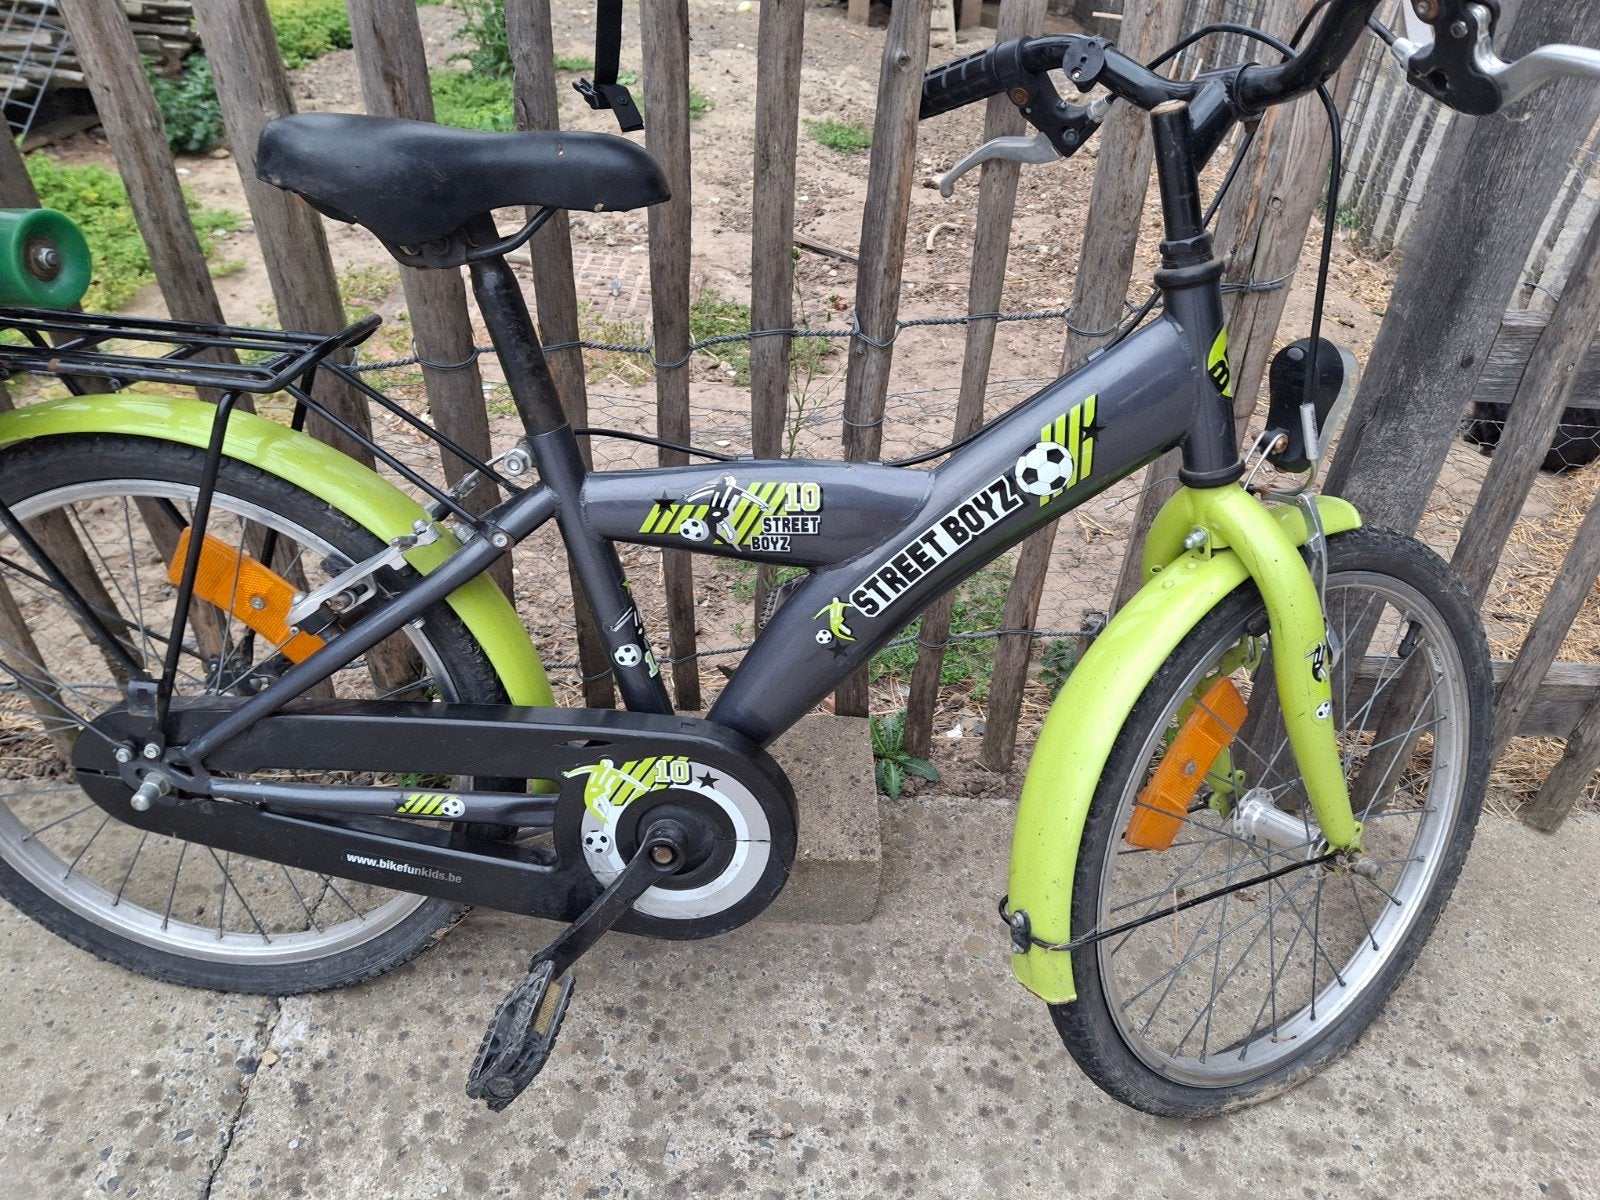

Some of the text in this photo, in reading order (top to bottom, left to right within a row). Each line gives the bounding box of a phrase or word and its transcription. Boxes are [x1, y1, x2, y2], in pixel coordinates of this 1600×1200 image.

[784, 482, 823, 512] 10
[762, 515, 820, 534] STREET
[751, 536, 791, 552] BOYZ
[851, 475, 1023, 617] STREET BOYZ
[654, 759, 692, 784] 10
[346, 852, 463, 884] www.bikefunkids.be
